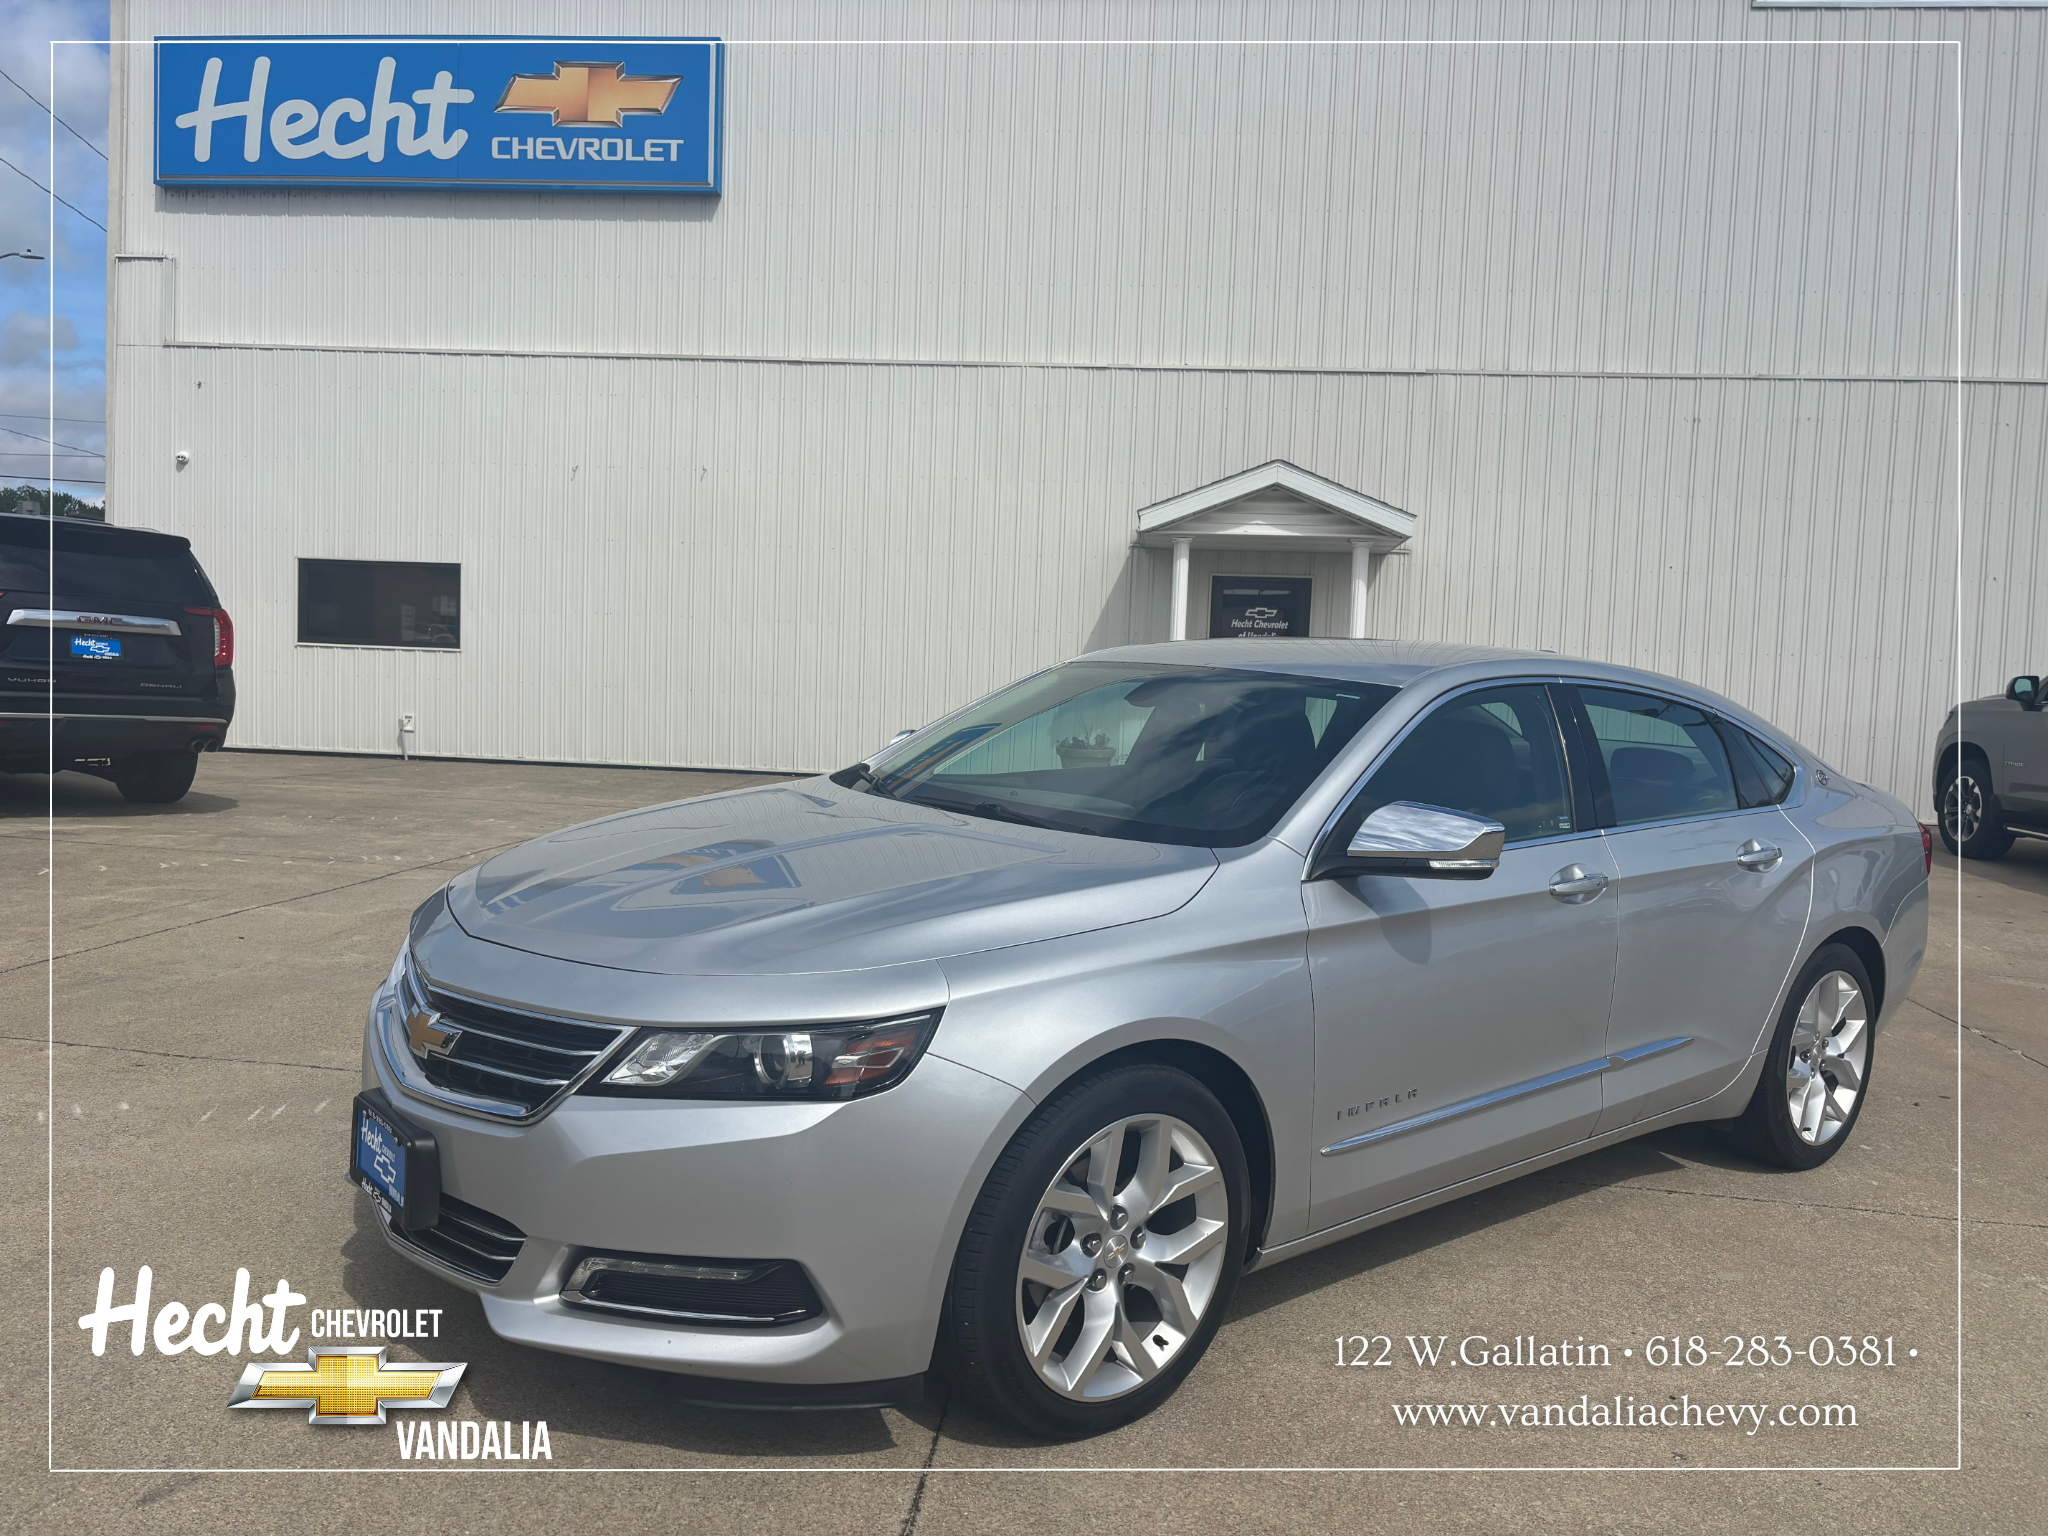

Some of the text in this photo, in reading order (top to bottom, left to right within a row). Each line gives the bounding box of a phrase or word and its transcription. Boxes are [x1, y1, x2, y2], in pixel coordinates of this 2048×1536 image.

[175, 56, 475, 162] Hecht
[492, 137, 683, 161] CHEVROLET
[77, 615, 123, 626] GMC
[1231, 619, 1289, 629] Hecht Chevrolet
[1337, 1088, 1418, 1120] IMPALA
[361, 1115, 383, 1155] Hecht
